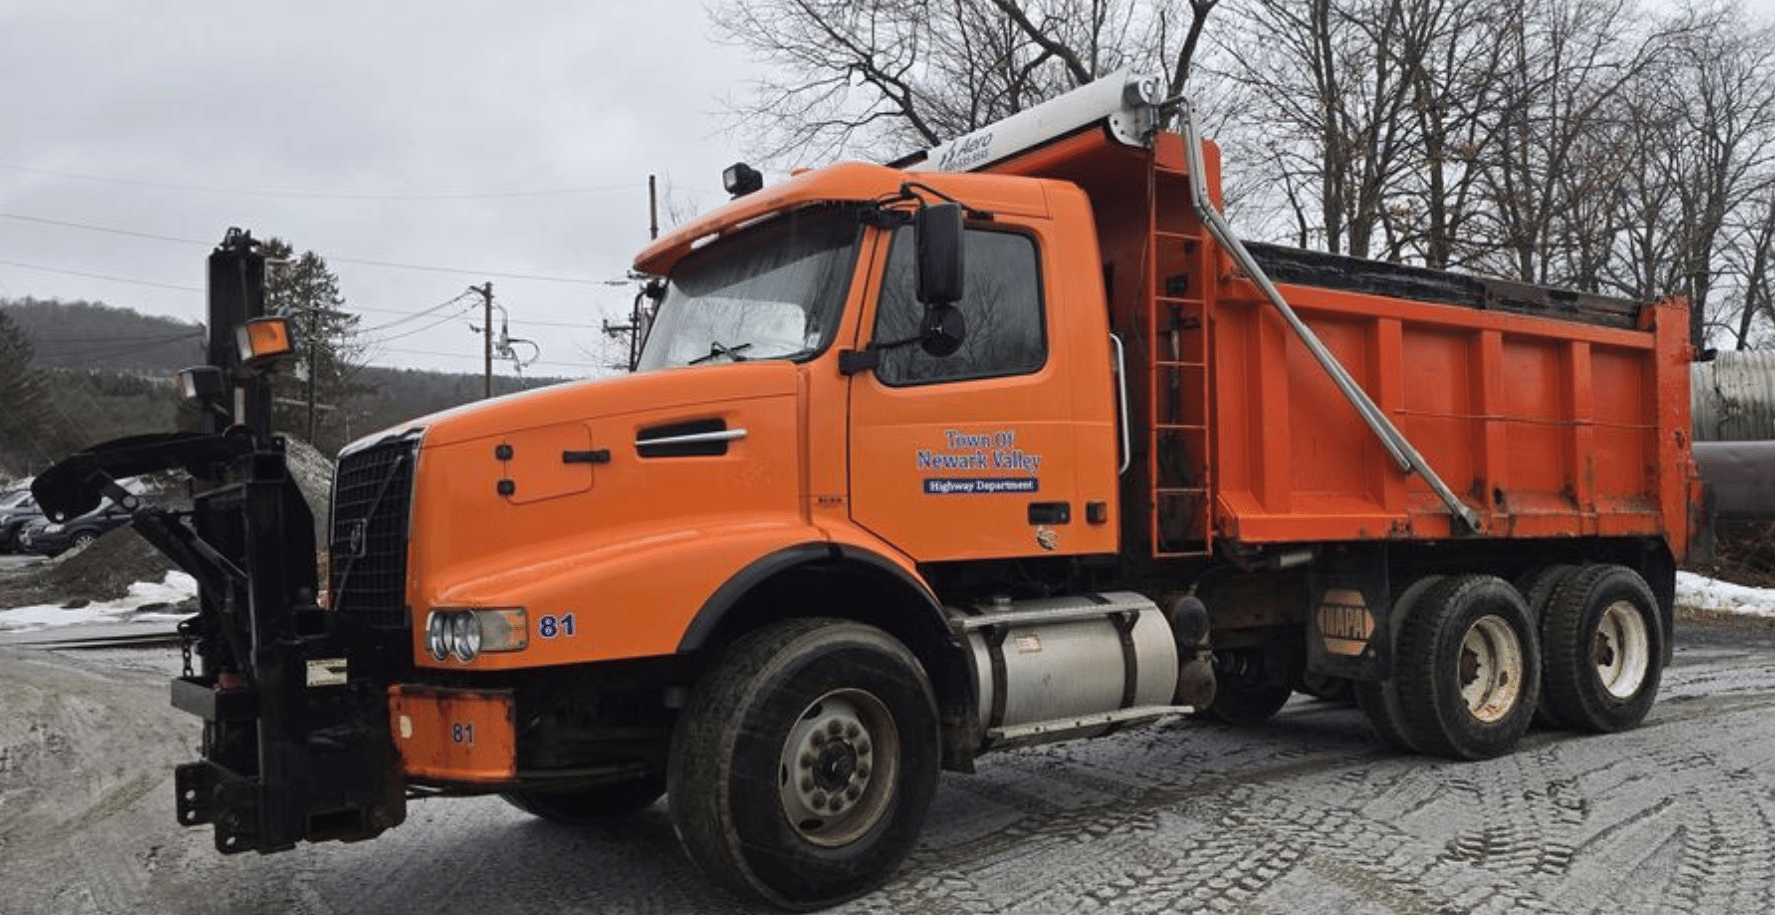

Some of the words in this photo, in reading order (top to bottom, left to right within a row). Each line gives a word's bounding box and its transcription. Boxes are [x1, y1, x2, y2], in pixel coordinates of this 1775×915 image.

[946, 429, 990, 449] Town
[995, 430, 1014, 448] Of
[917, 449, 986, 469] Newark
[993, 449, 1041, 476] Valley
[929, 481, 974, 494] Highway
[977, 480, 1033, 492] Department
[539, 613, 575, 638] 81
[1325, 606, 1364, 639] NAPA
[453, 723, 475, 745] 81
